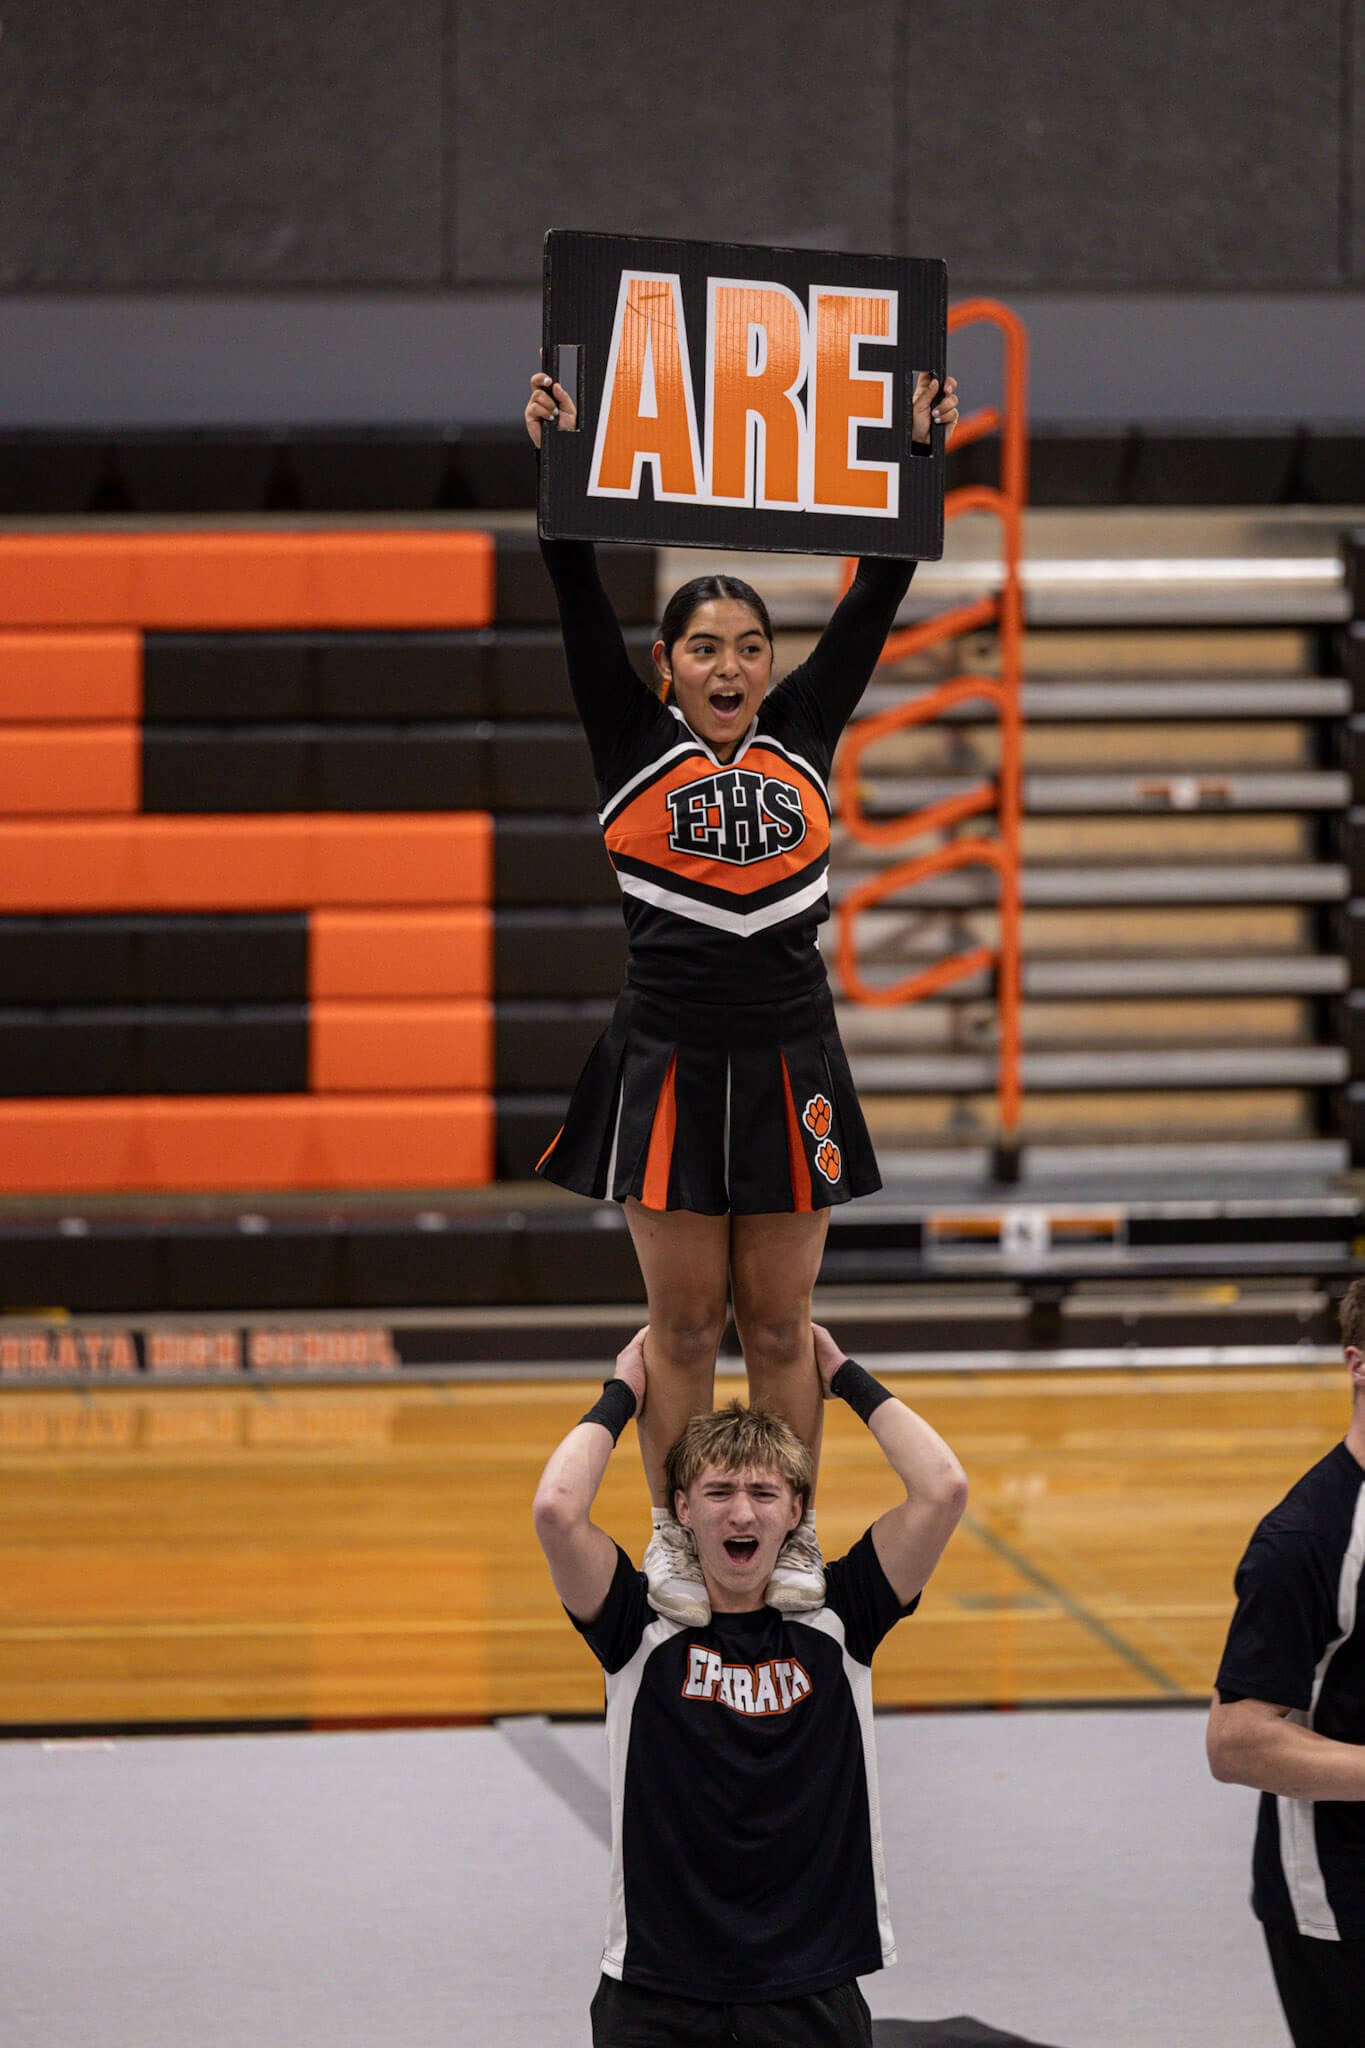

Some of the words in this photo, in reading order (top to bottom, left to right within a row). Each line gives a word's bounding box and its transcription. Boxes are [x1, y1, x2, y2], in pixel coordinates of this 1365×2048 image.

[587, 269, 900, 519] ARE
[665, 767, 806, 867] EHS
[251, 1327, 399, 1373] SCHOOL
[682, 1643, 813, 1717] EPHRATA
